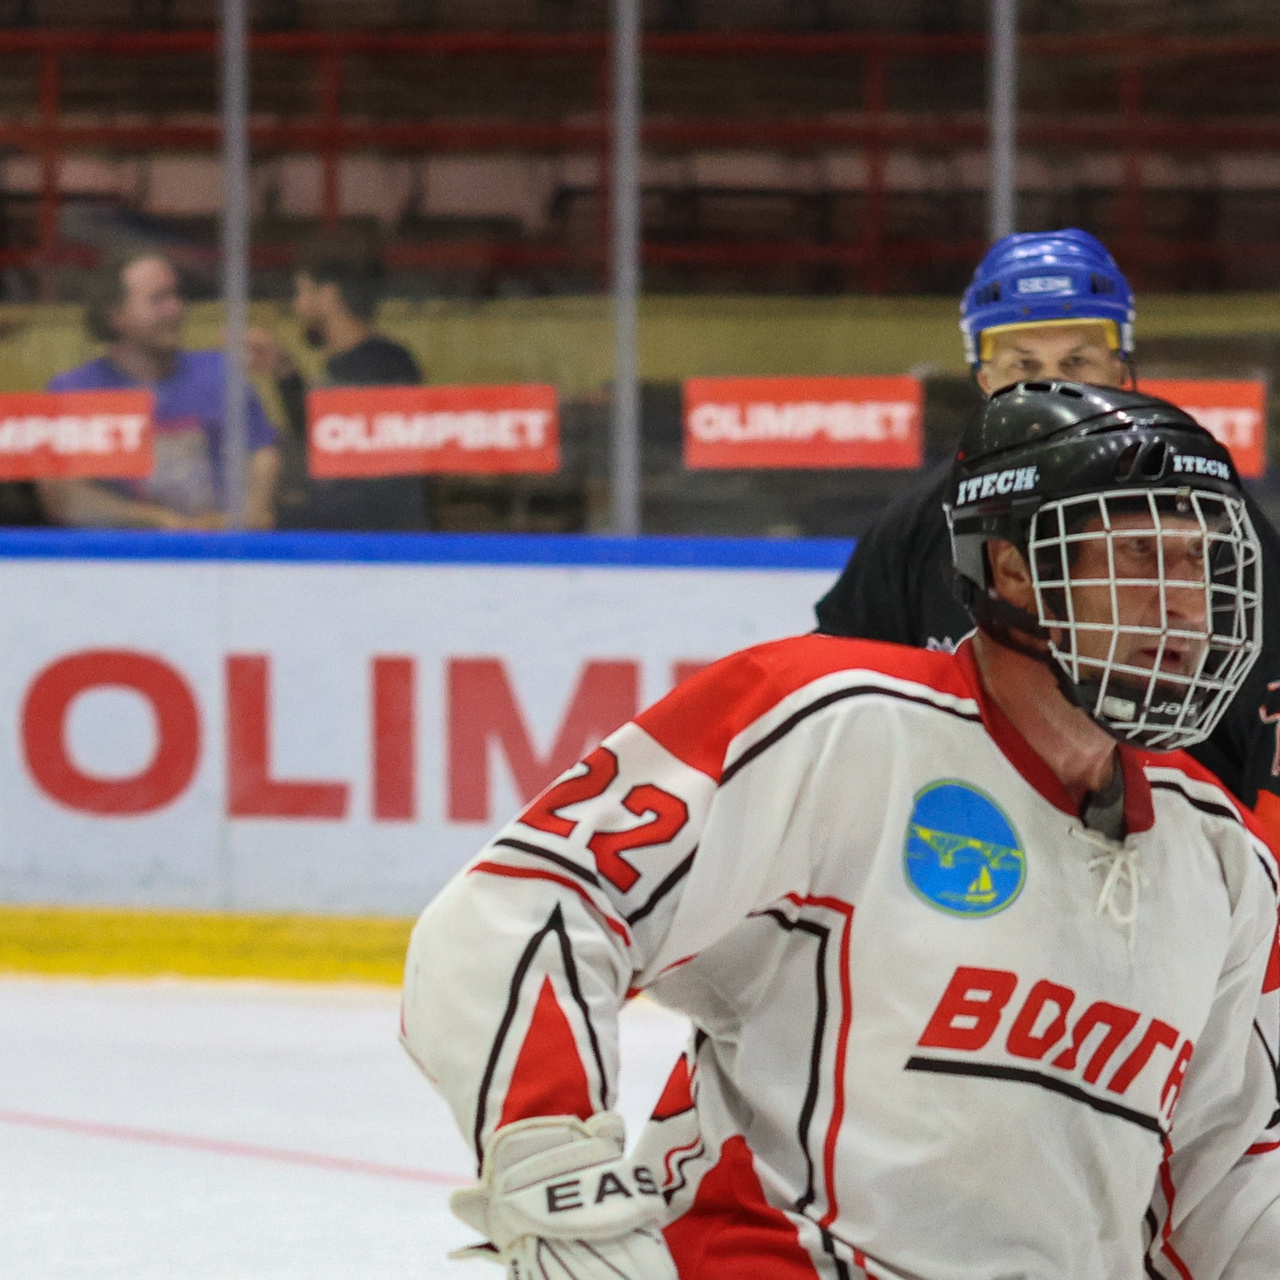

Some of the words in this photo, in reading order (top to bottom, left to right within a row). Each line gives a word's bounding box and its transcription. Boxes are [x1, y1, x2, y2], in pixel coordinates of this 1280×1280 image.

[312, 409, 550, 452] OLIMPBET
[687, 401, 915, 444] OLIMPBET
[956, 465, 1039, 505] ITECH
[1173, 455, 1230, 480] ITECH
[18, 646, 712, 825] OLIM
[517, 746, 690, 895] 22
[545, 1166, 660, 1214] EAS
